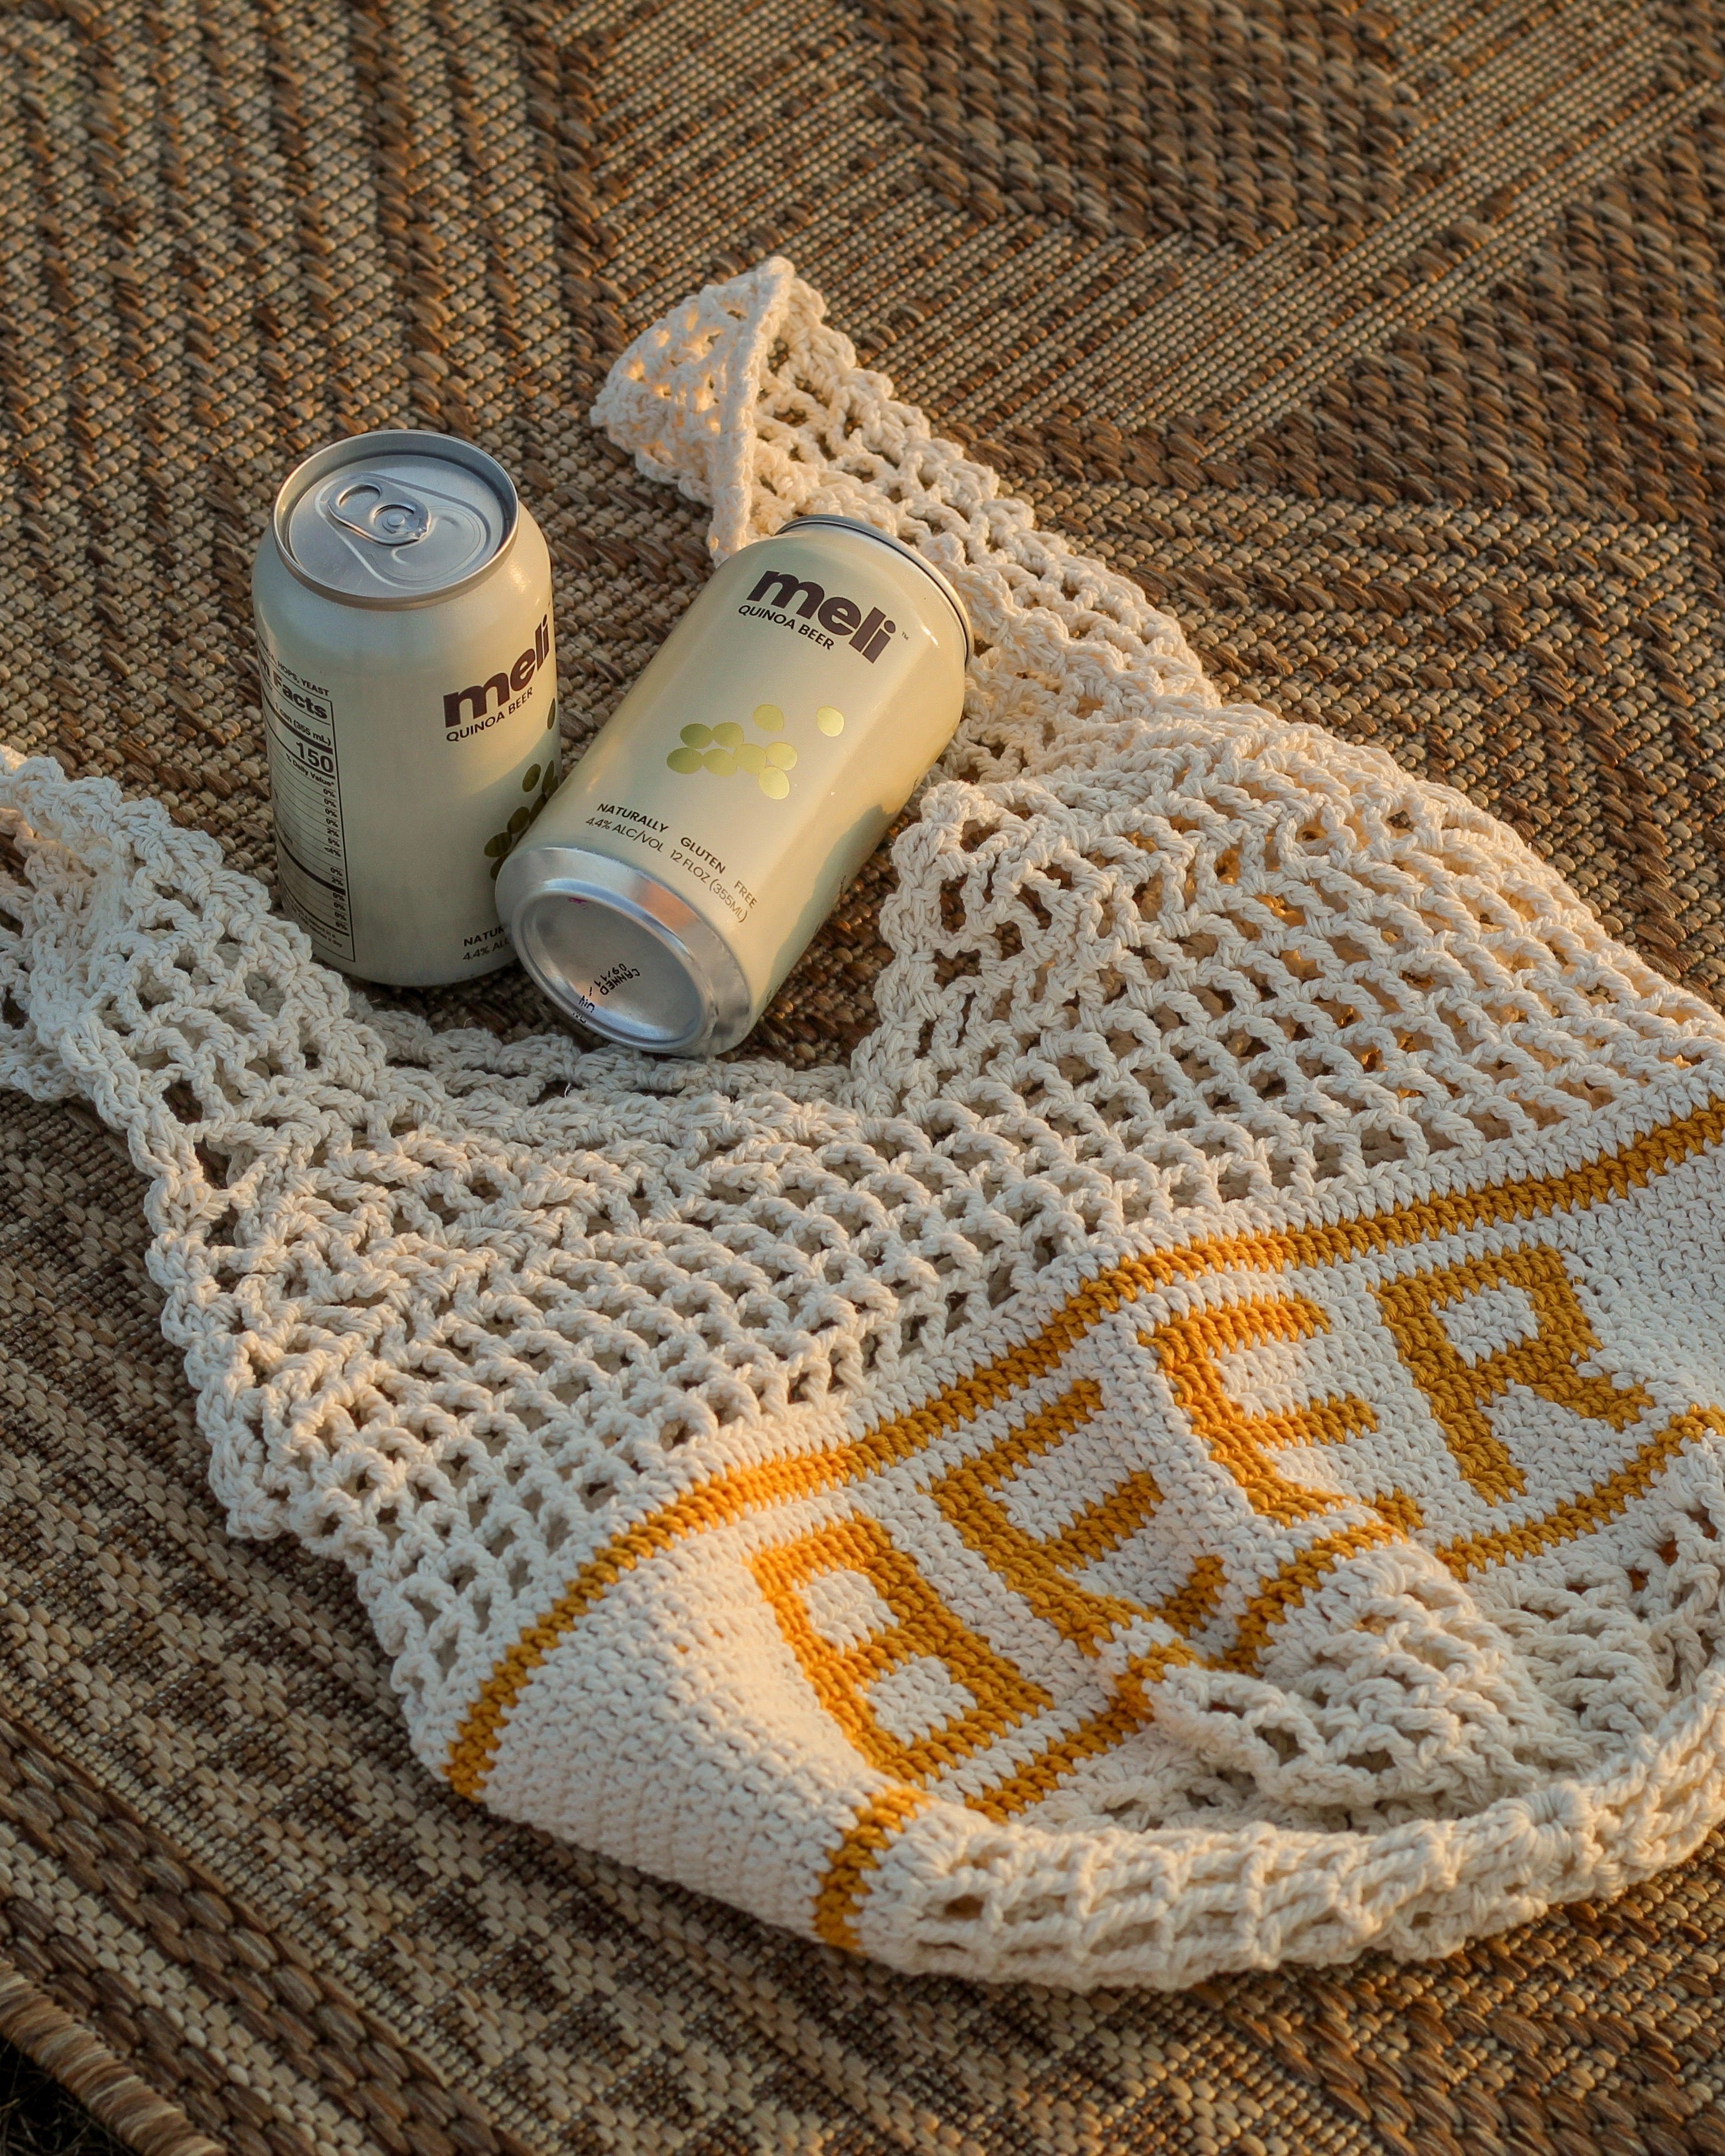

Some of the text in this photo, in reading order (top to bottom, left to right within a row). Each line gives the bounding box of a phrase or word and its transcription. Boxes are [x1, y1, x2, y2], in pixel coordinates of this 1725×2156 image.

[738, 605, 834, 650] QUINOA BEER
[746, 570, 896, 664] meli
[443, 614, 550, 728] meli
[273, 670, 327, 719] Facts
[301, 678, 329, 696] YEAST
[280, 709, 292, 723] can
[294, 719, 311, 735] (355
[313, 732, 331, 746] mL)
[446, 687, 533, 742] QUINOA BEER
[292, 760, 309, 776] Daily
[296, 742, 334, 773] 150
[323, 788, 336, 798] 0%
[324, 798, 337, 808] 0%
[325, 808, 337, 817] 0%
[326, 818, 339, 828] 0%
[327, 828, 339, 837] 2%
[597, 803, 758, 909] NATURALLY GLUTEN FREE
[330, 867, 343, 877] 0%
[331, 877, 344, 887] 2%
[585, 817, 612, 830] 4.4%
[612, 823, 664, 853] ALC/VOL
[670, 849, 684, 863] 12
[709, 878, 748, 923] (355ML)
[462, 946, 490, 960] 4.4%
[600, 968, 640, 995] CANNED
[748, 1243, 1655, 1790] BEER
